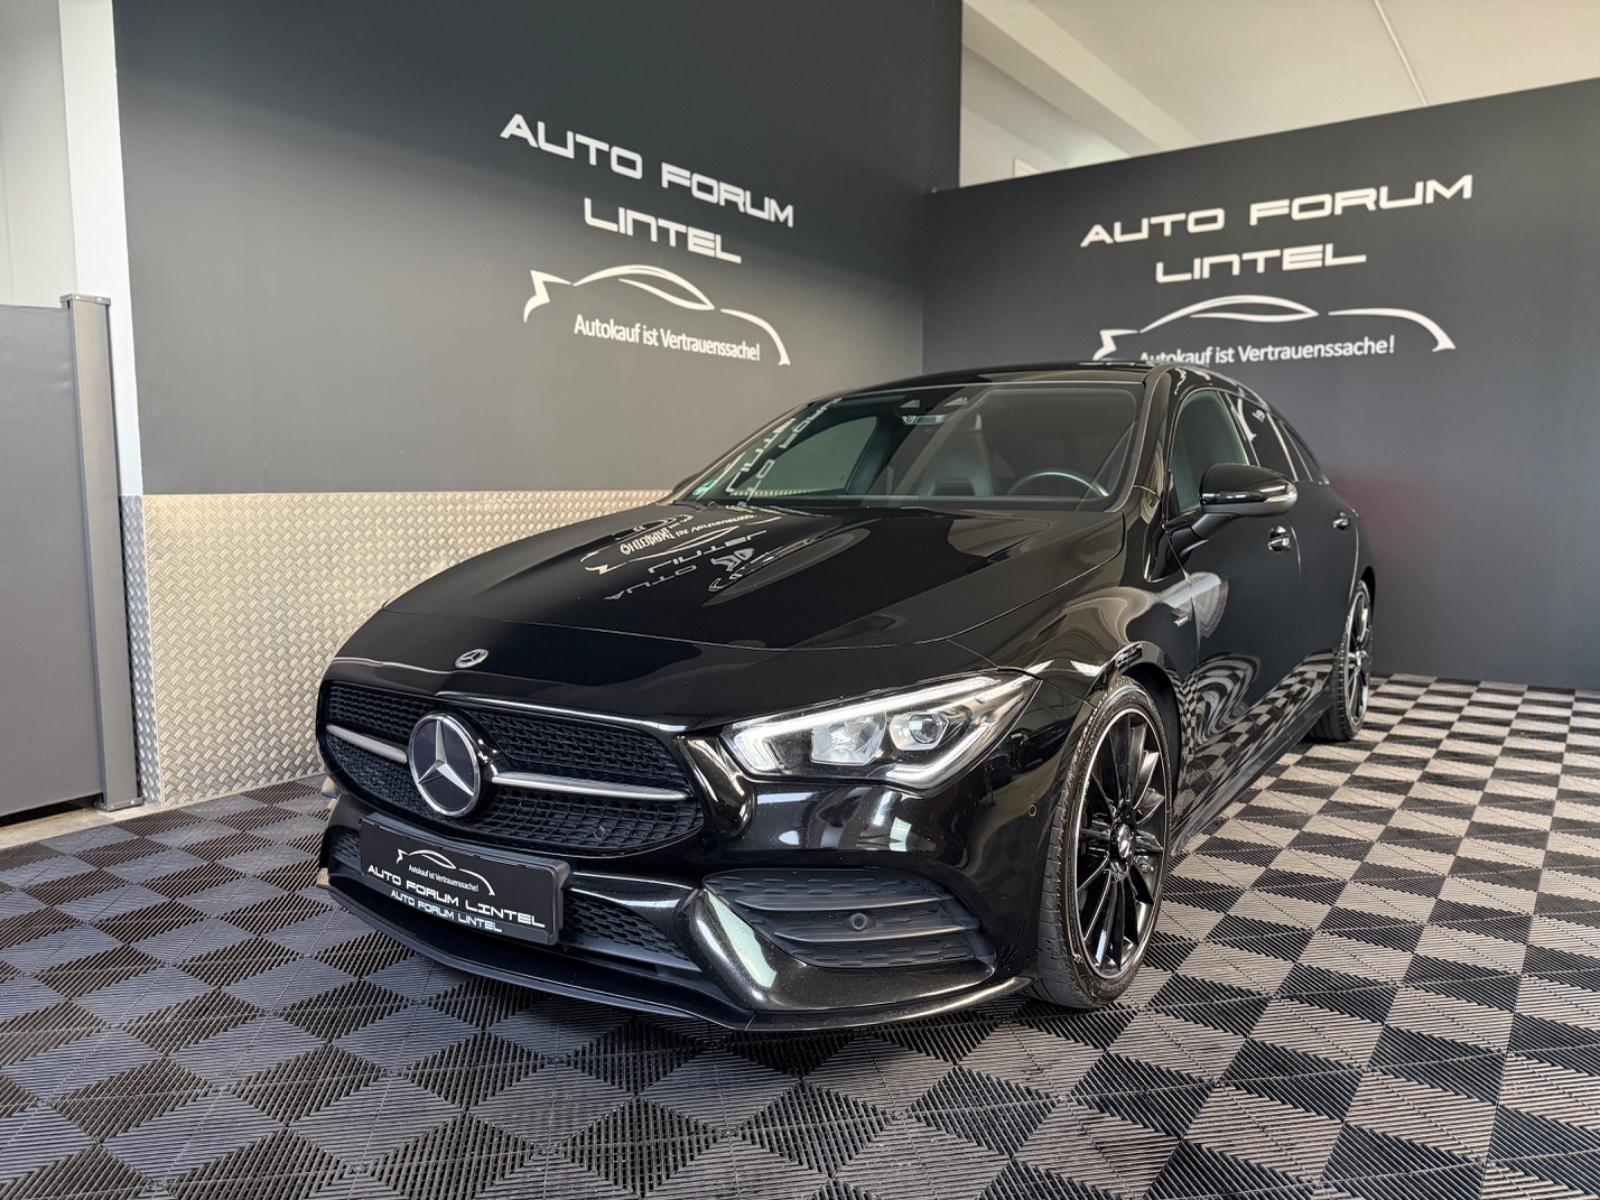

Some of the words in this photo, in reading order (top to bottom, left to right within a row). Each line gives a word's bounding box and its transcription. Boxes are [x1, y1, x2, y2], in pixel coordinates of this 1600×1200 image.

[500, 113, 643, 180] AUTO
[661, 162, 794, 228] FORUM
[584, 197, 742, 264] LINTEL
[1079, 208, 1226, 248] AUTO
[1249, 174, 1473, 226] FORUM
[1156, 243, 1367, 284] LINTEL
[574, 314, 642, 344] Autokauf
[642, 325, 659, 347] ist
[660, 328, 761, 362] Vertrauenssache!
[1215, 346, 1236, 364] ist
[1238, 335, 1396, 363] Vertrauenssache!
[367, 864, 402, 886] AUTO
[406, 880, 460, 907] FORUM
[465, 899, 546, 929] LINTEL
[390, 888, 415, 906] AUTO
[417, 900, 455, 920] FORUM
[457, 913, 503, 933] LINTEL
